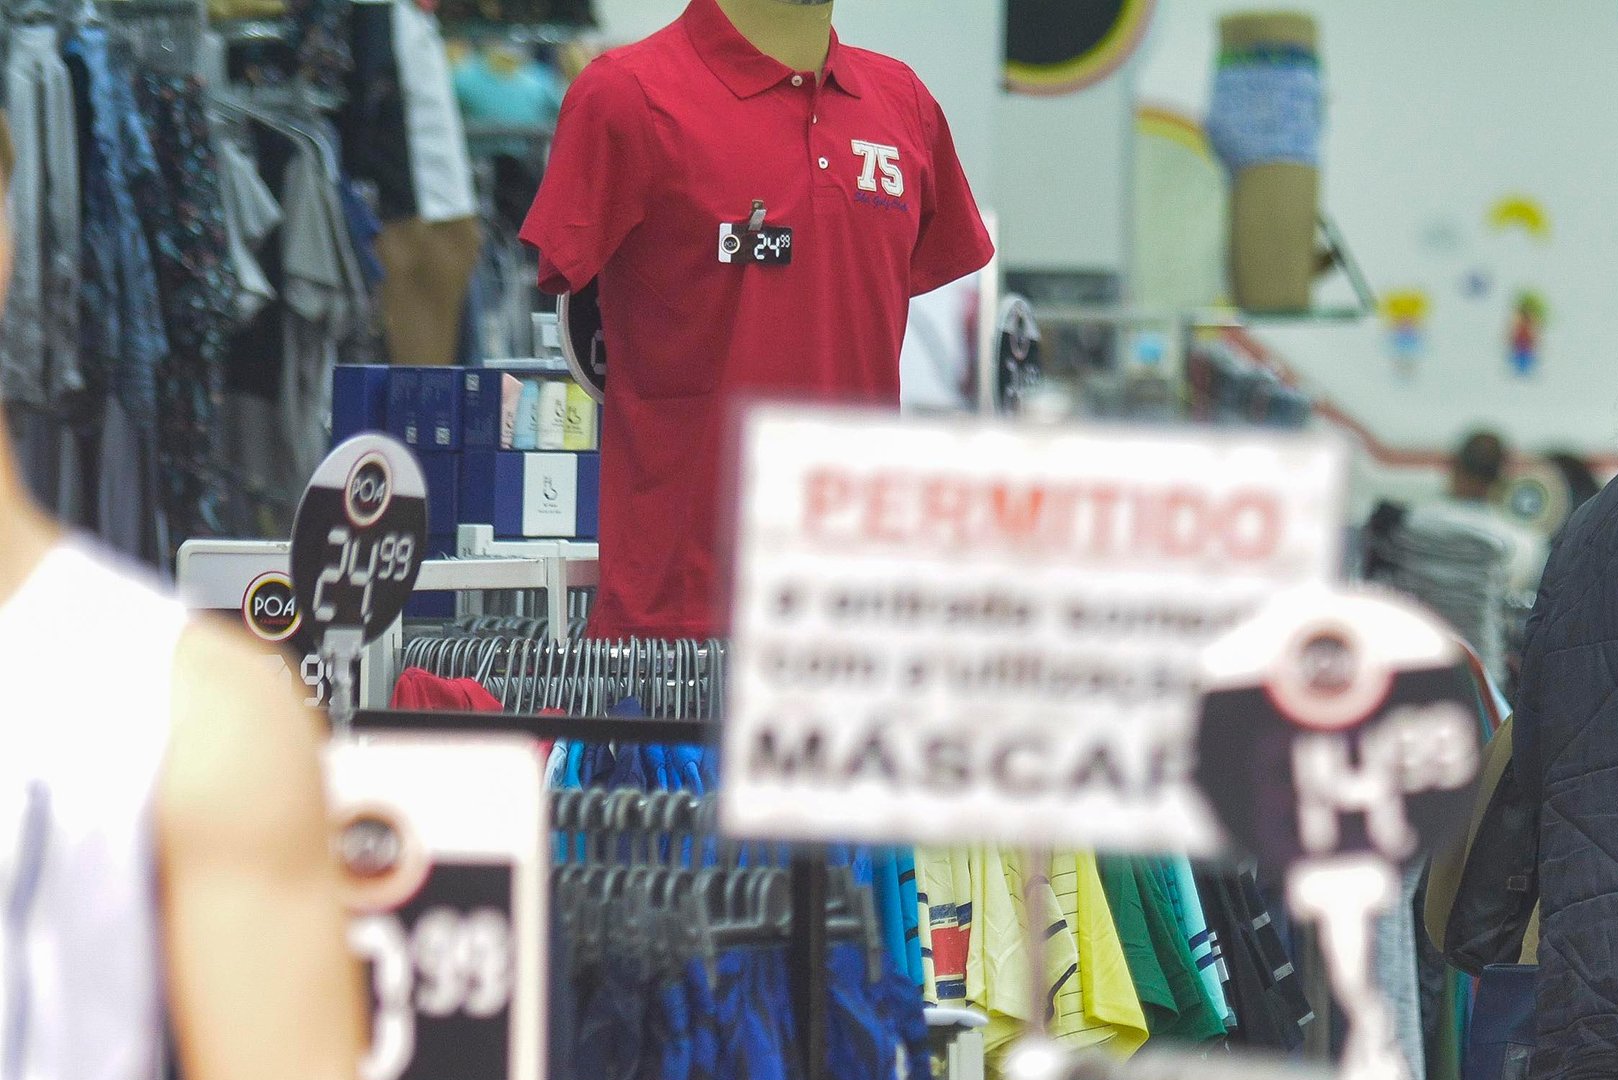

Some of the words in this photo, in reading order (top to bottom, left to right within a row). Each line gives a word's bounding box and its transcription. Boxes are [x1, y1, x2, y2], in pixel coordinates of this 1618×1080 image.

[850, 138, 904, 198] 75
[352, 478, 386, 502] POA
[798, 460, 1288, 562] PERMITIDO
[254, 596, 297, 617] POA
